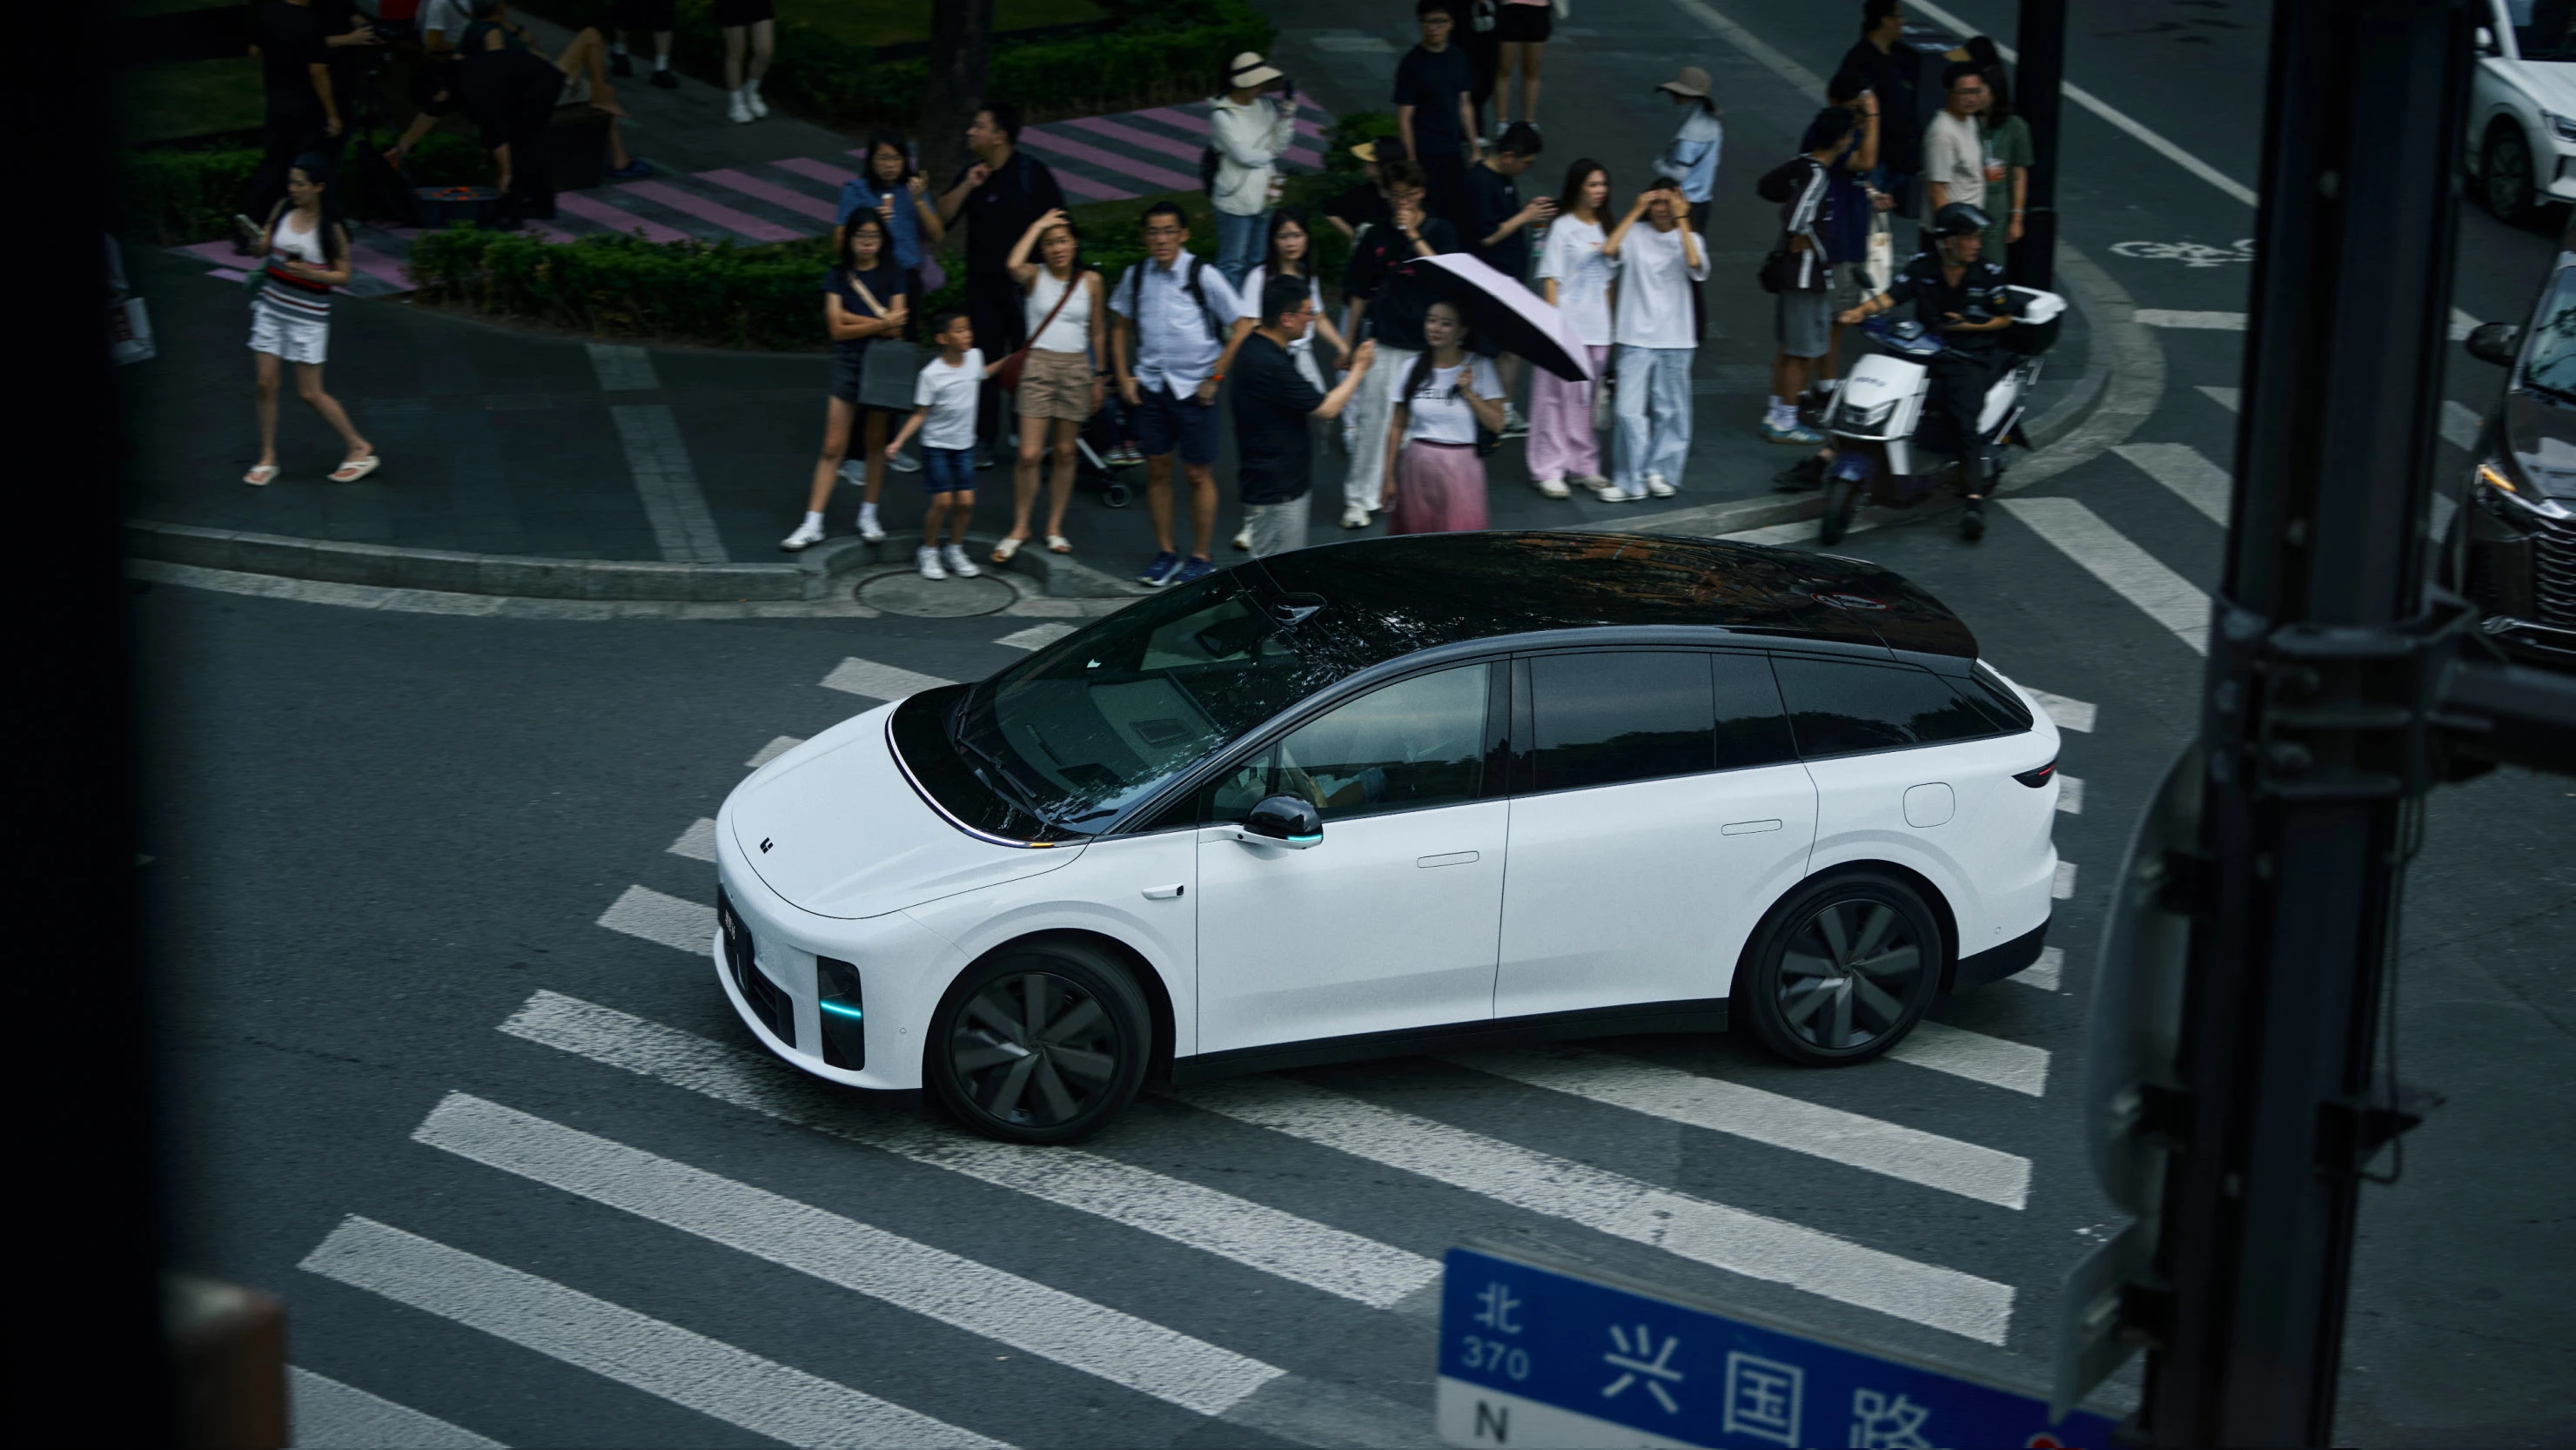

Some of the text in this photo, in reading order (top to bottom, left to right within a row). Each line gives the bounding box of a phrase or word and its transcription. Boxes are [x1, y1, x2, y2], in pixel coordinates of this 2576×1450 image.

[1472, 1281, 1523, 1336] 北
[1461, 1335, 1531, 1382] 370
[1601, 1323, 1934, 1449] 兴国路
[1475, 1400, 1509, 1444] N
